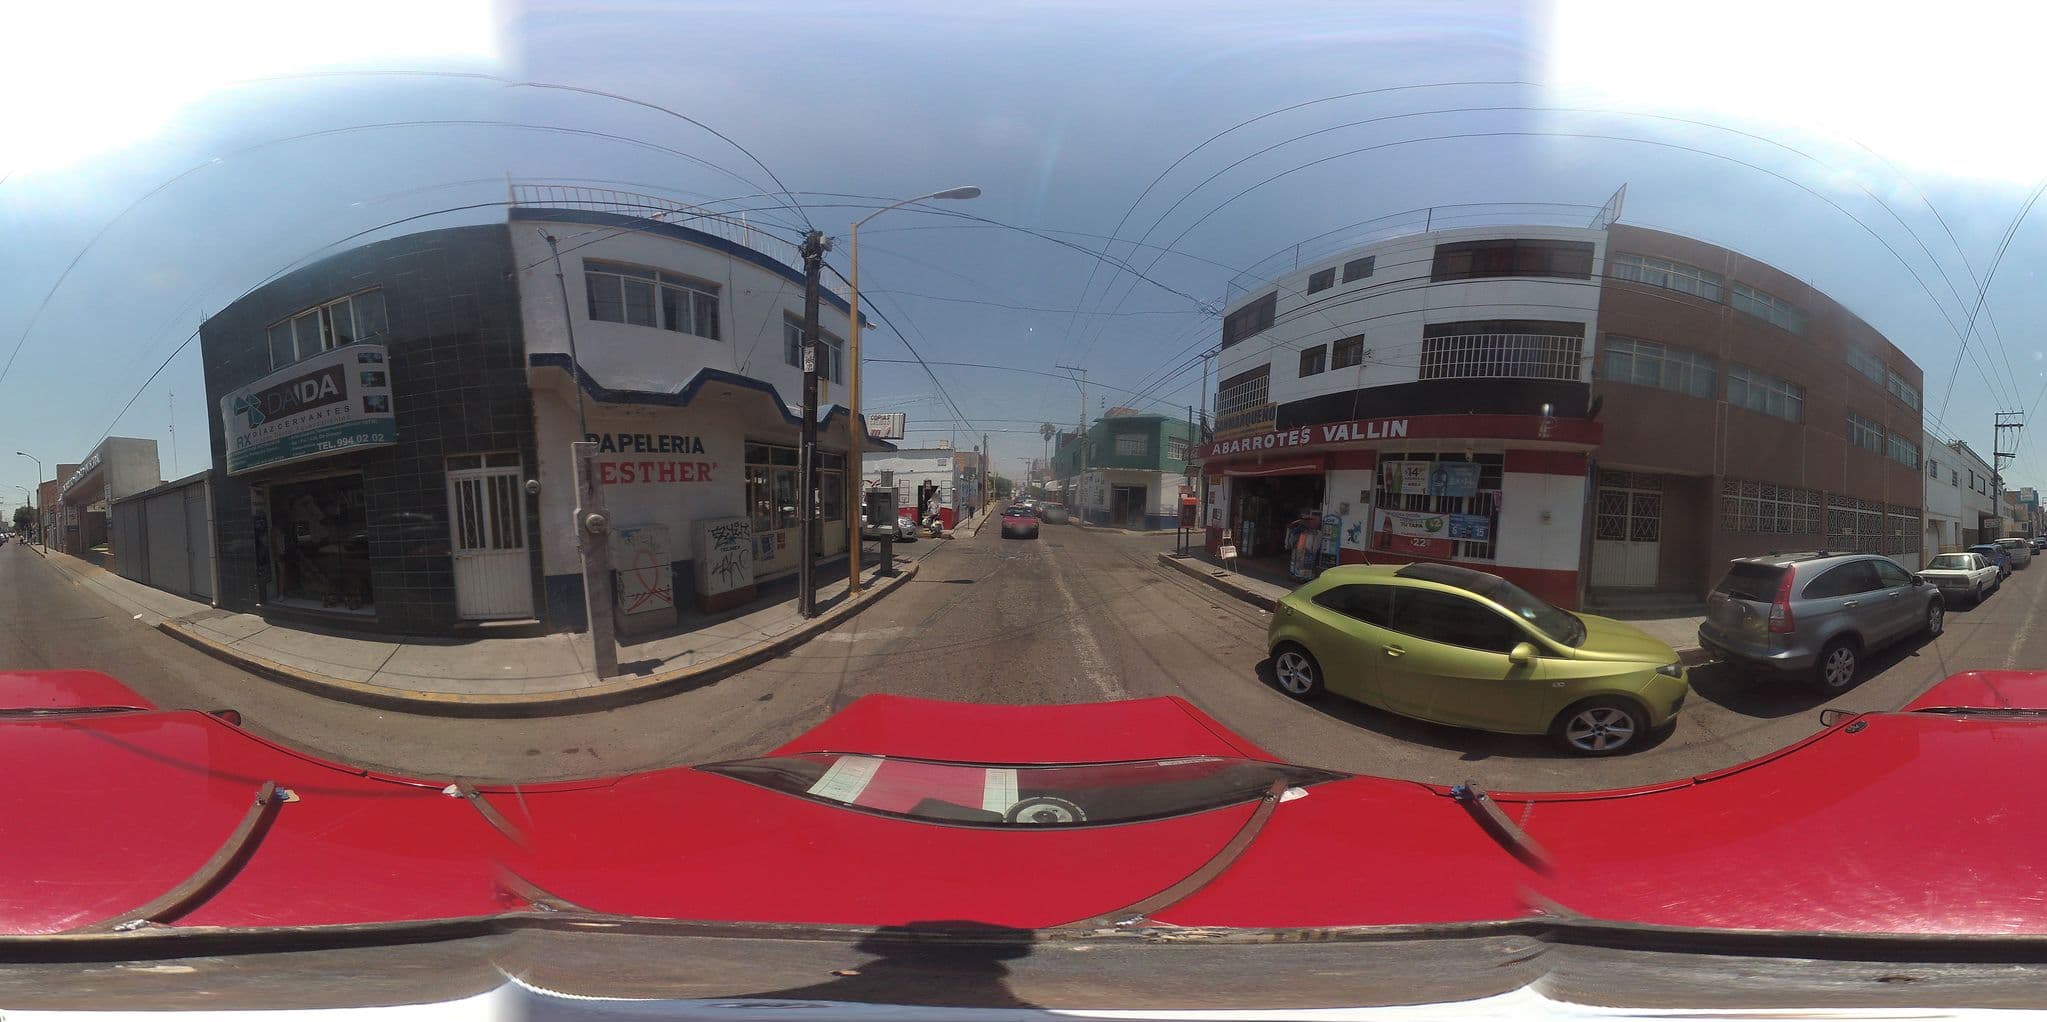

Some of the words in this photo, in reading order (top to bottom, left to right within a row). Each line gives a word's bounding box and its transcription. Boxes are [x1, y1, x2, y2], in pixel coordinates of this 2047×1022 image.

[337, 437, 355, 448] 994
[356, 434, 371, 444] 02
[371, 433, 385, 443] 02
[584, 432, 705, 454] PAPELERIA
[1212, 427, 1311, 456] ABARROTES
[1322, 419, 1409, 442] VALLIN
